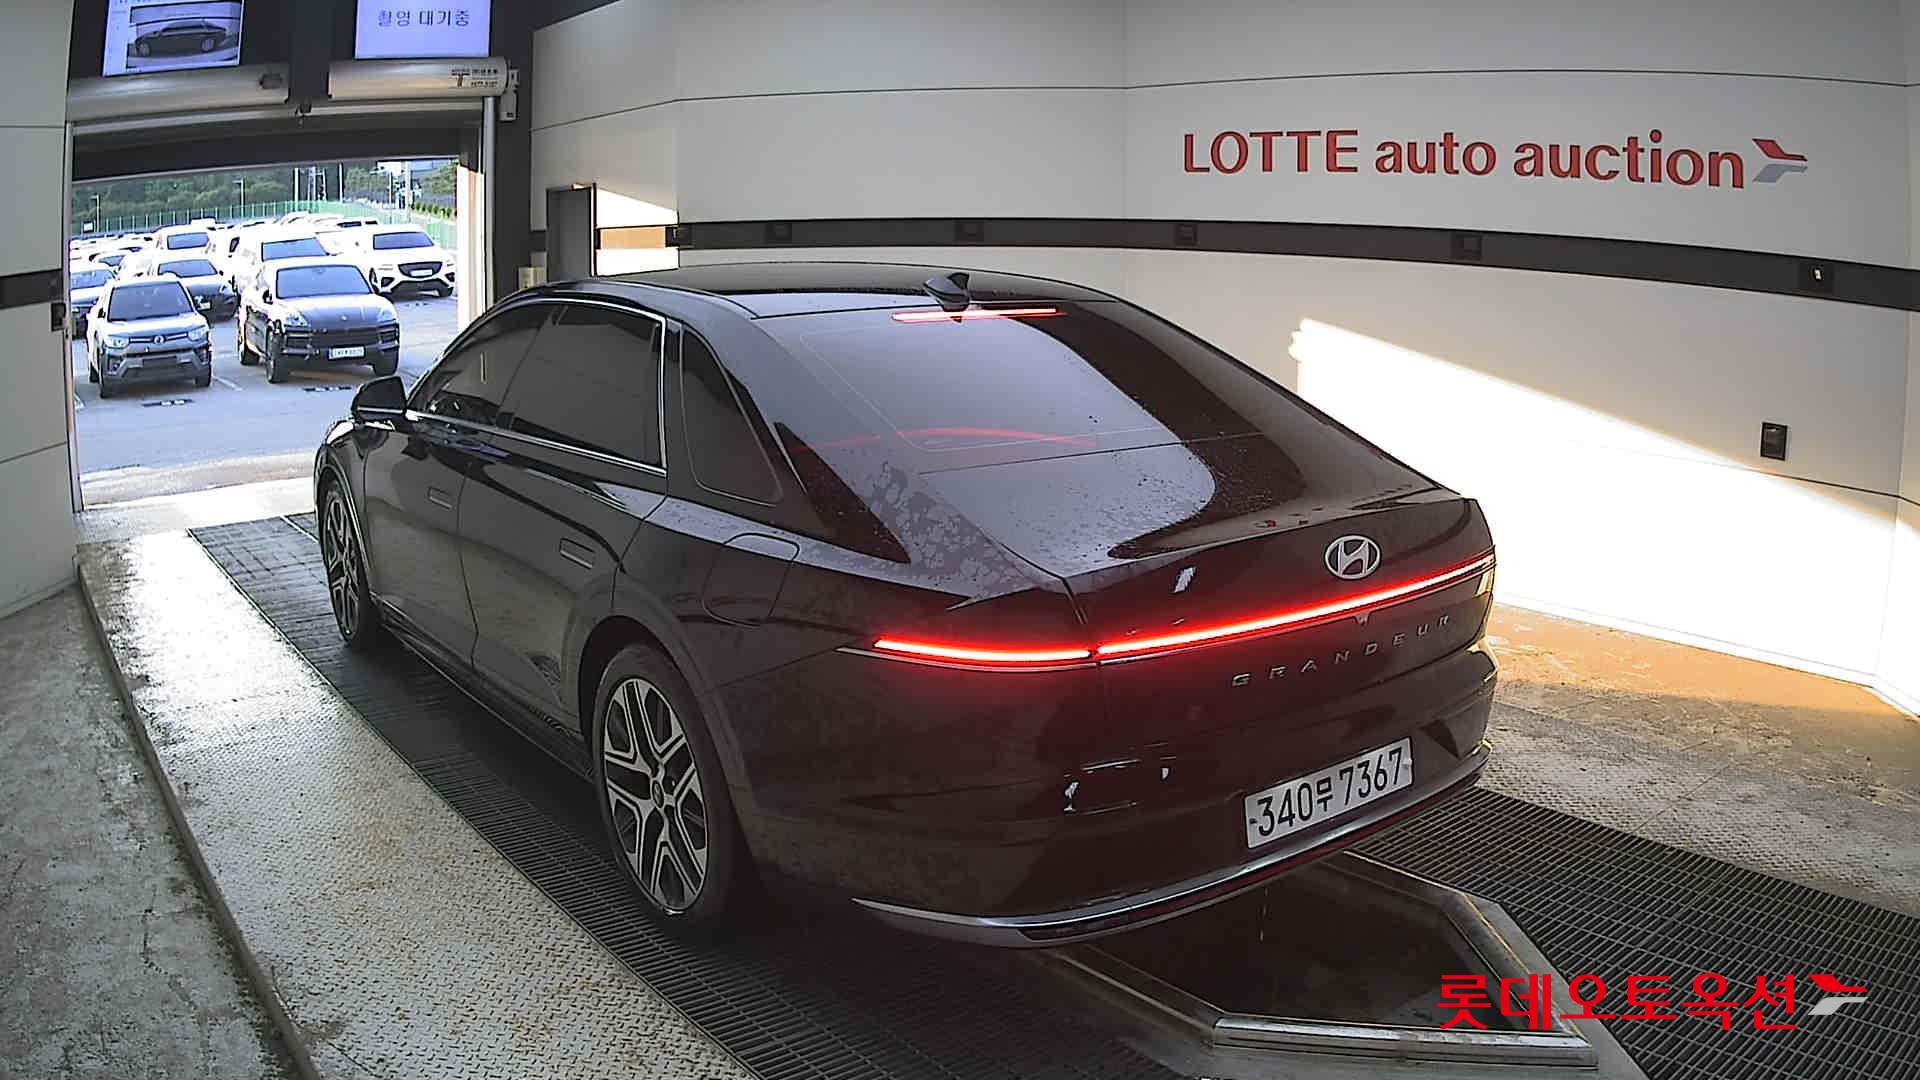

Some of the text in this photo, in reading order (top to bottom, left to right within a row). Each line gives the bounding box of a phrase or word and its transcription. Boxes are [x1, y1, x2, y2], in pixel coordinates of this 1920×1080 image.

[419, 9, 470, 27] 대기중
[1184, 130, 1745, 188] LOTTE auto auction
[1231, 615, 1449, 687] GRANDEUR
